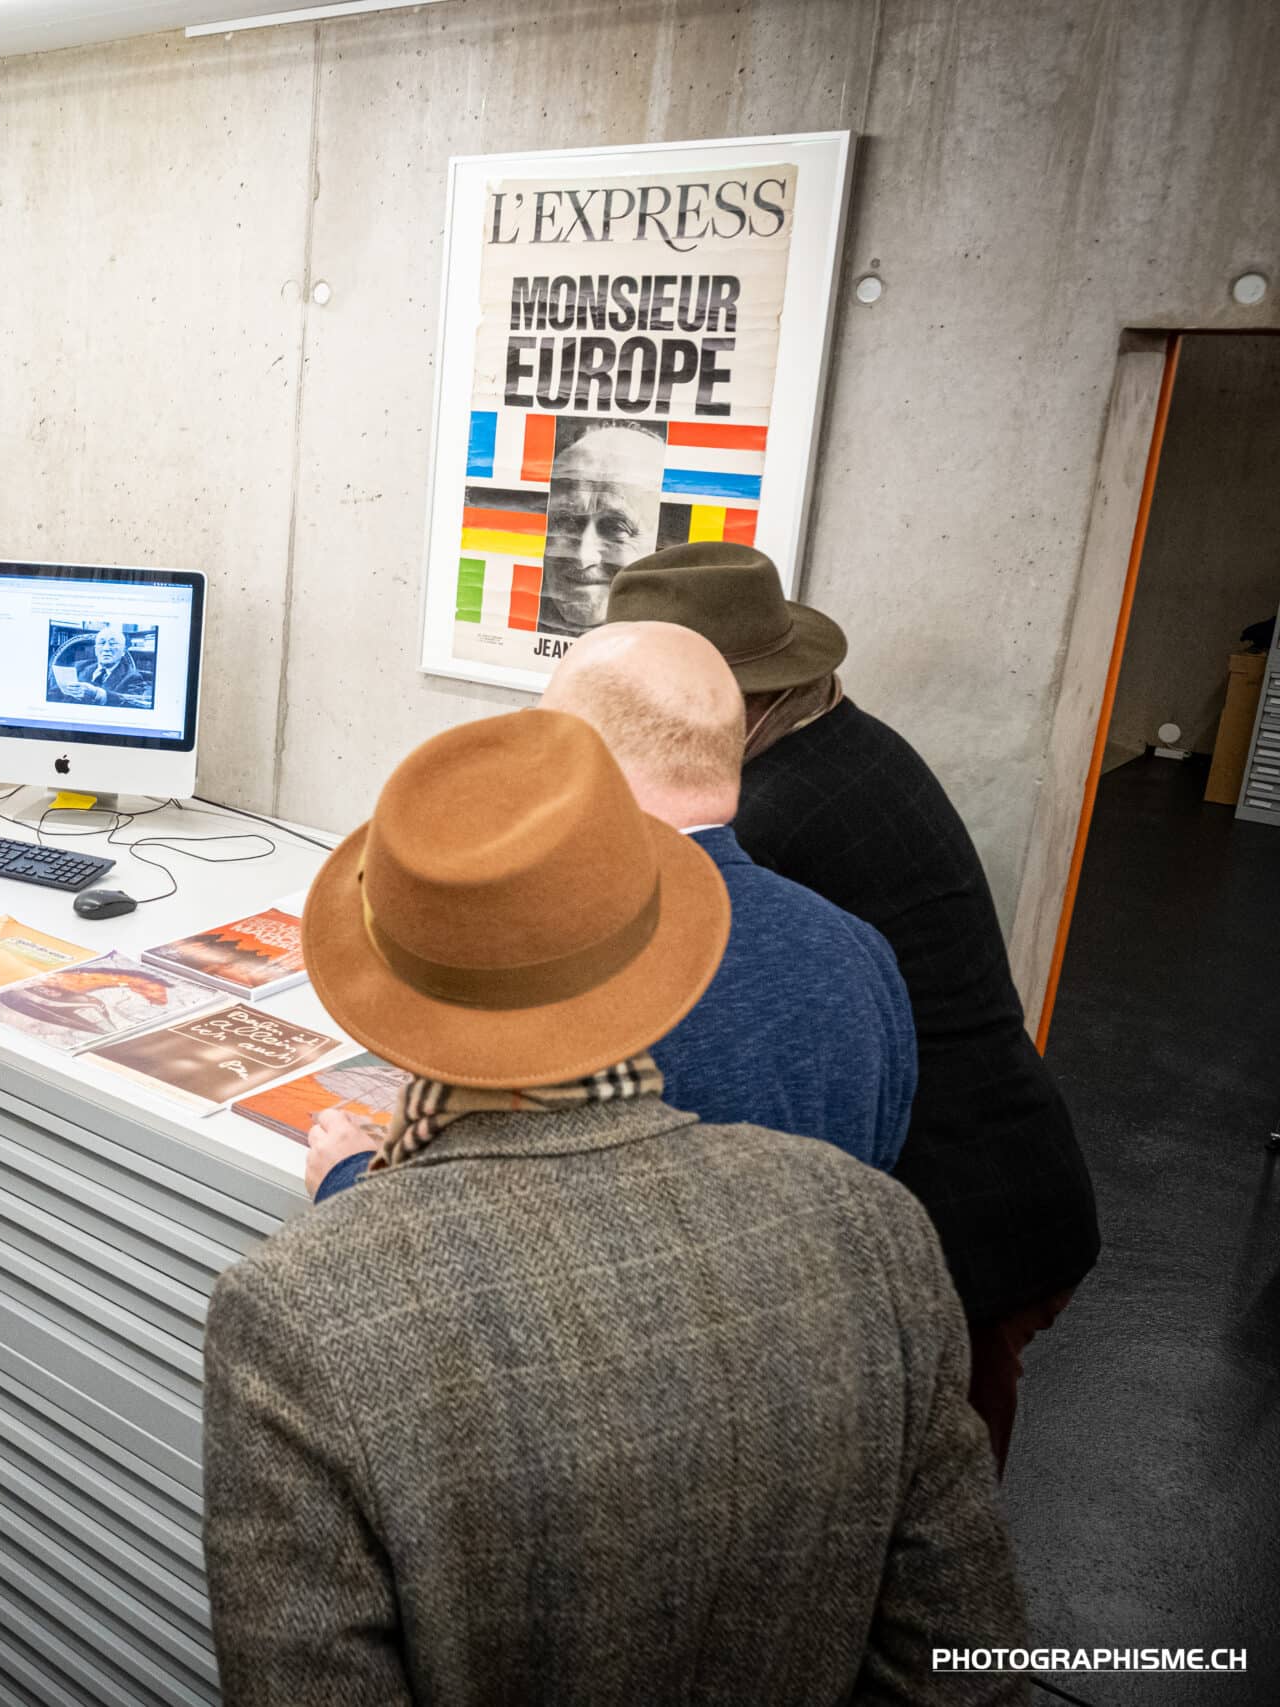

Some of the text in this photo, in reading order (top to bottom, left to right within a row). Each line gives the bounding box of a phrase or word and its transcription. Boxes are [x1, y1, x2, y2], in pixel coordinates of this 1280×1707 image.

[488, 179, 786, 252] L'EXPRESS
[509, 275, 740, 332] MONSIEUR
[504, 336, 737, 416] EUROPE
